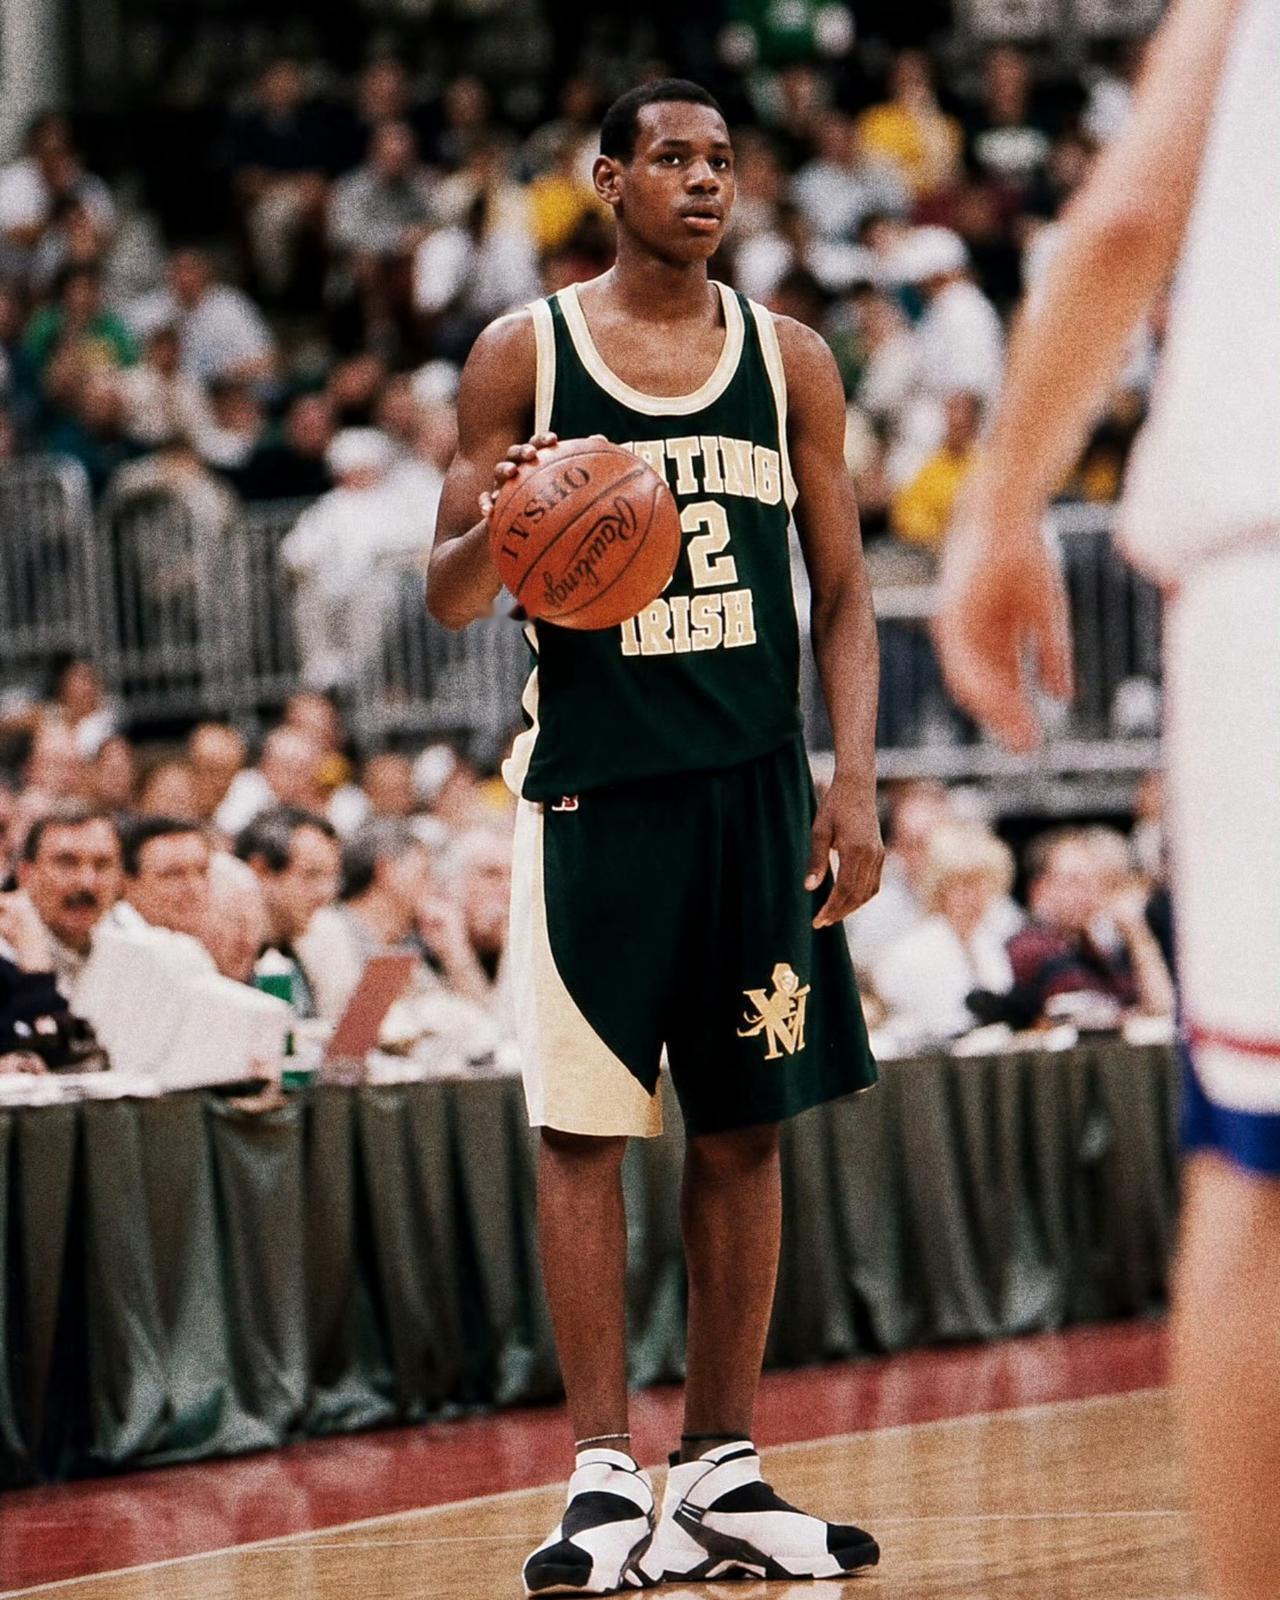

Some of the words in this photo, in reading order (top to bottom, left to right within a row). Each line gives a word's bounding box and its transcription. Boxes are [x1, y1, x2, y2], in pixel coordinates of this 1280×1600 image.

[619, 435, 781, 505] HTING
[543, 496, 637, 607] Rawlings
[661, 500, 738, 588] 2
[620, 588, 757, 656] IRISH
